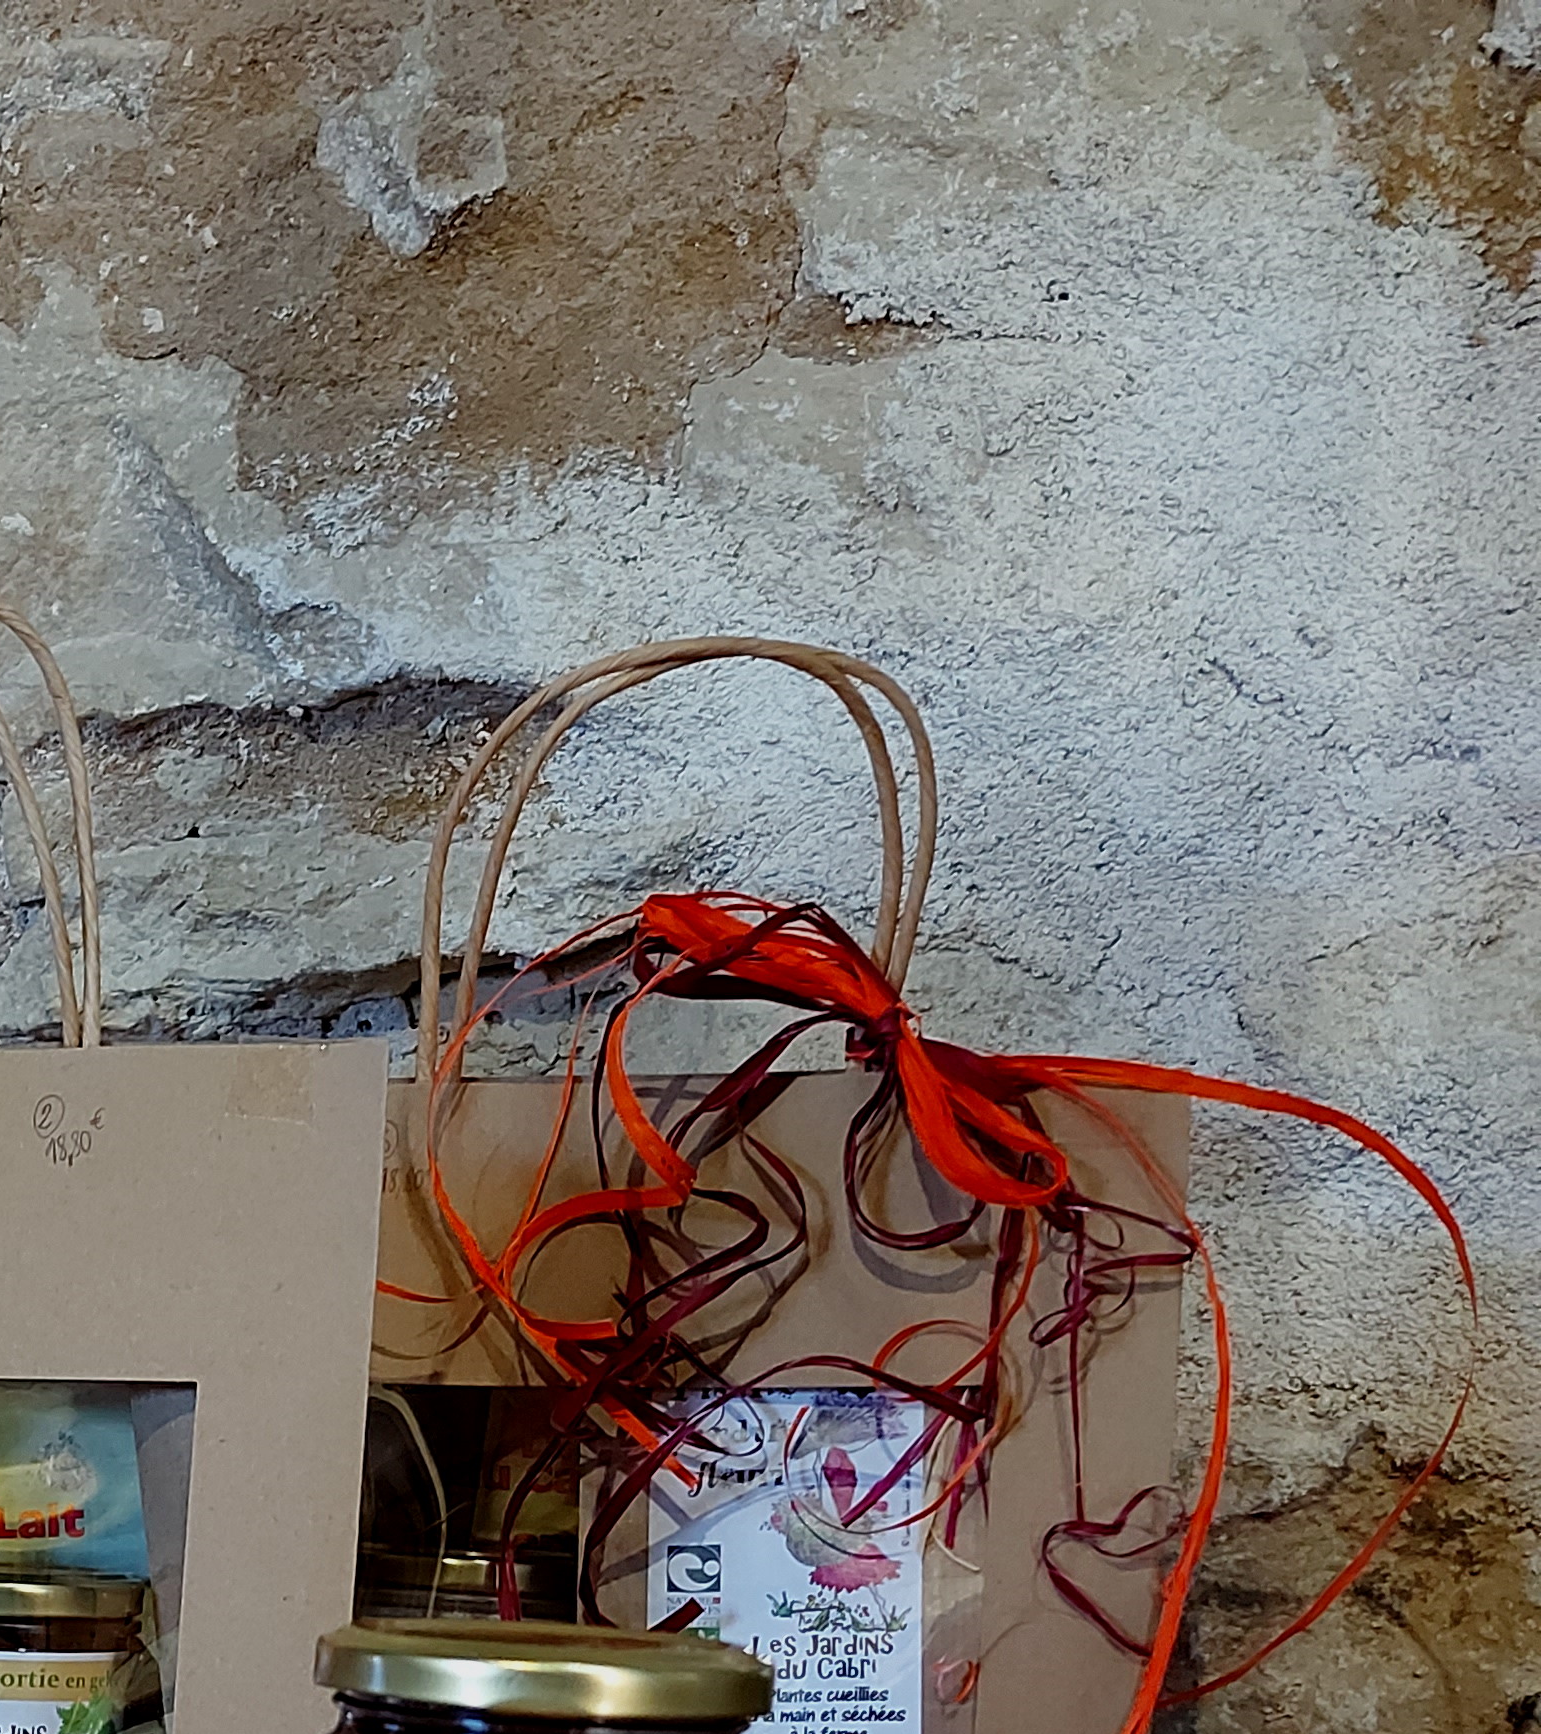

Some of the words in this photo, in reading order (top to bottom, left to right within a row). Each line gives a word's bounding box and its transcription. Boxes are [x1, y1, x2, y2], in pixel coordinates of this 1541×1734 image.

[65, 1676, 86, 1689] en
[780, 1708, 816, 1723] main
[821, 1709, 837, 1722] et
[842, 1705, 907, 1723] séchées
